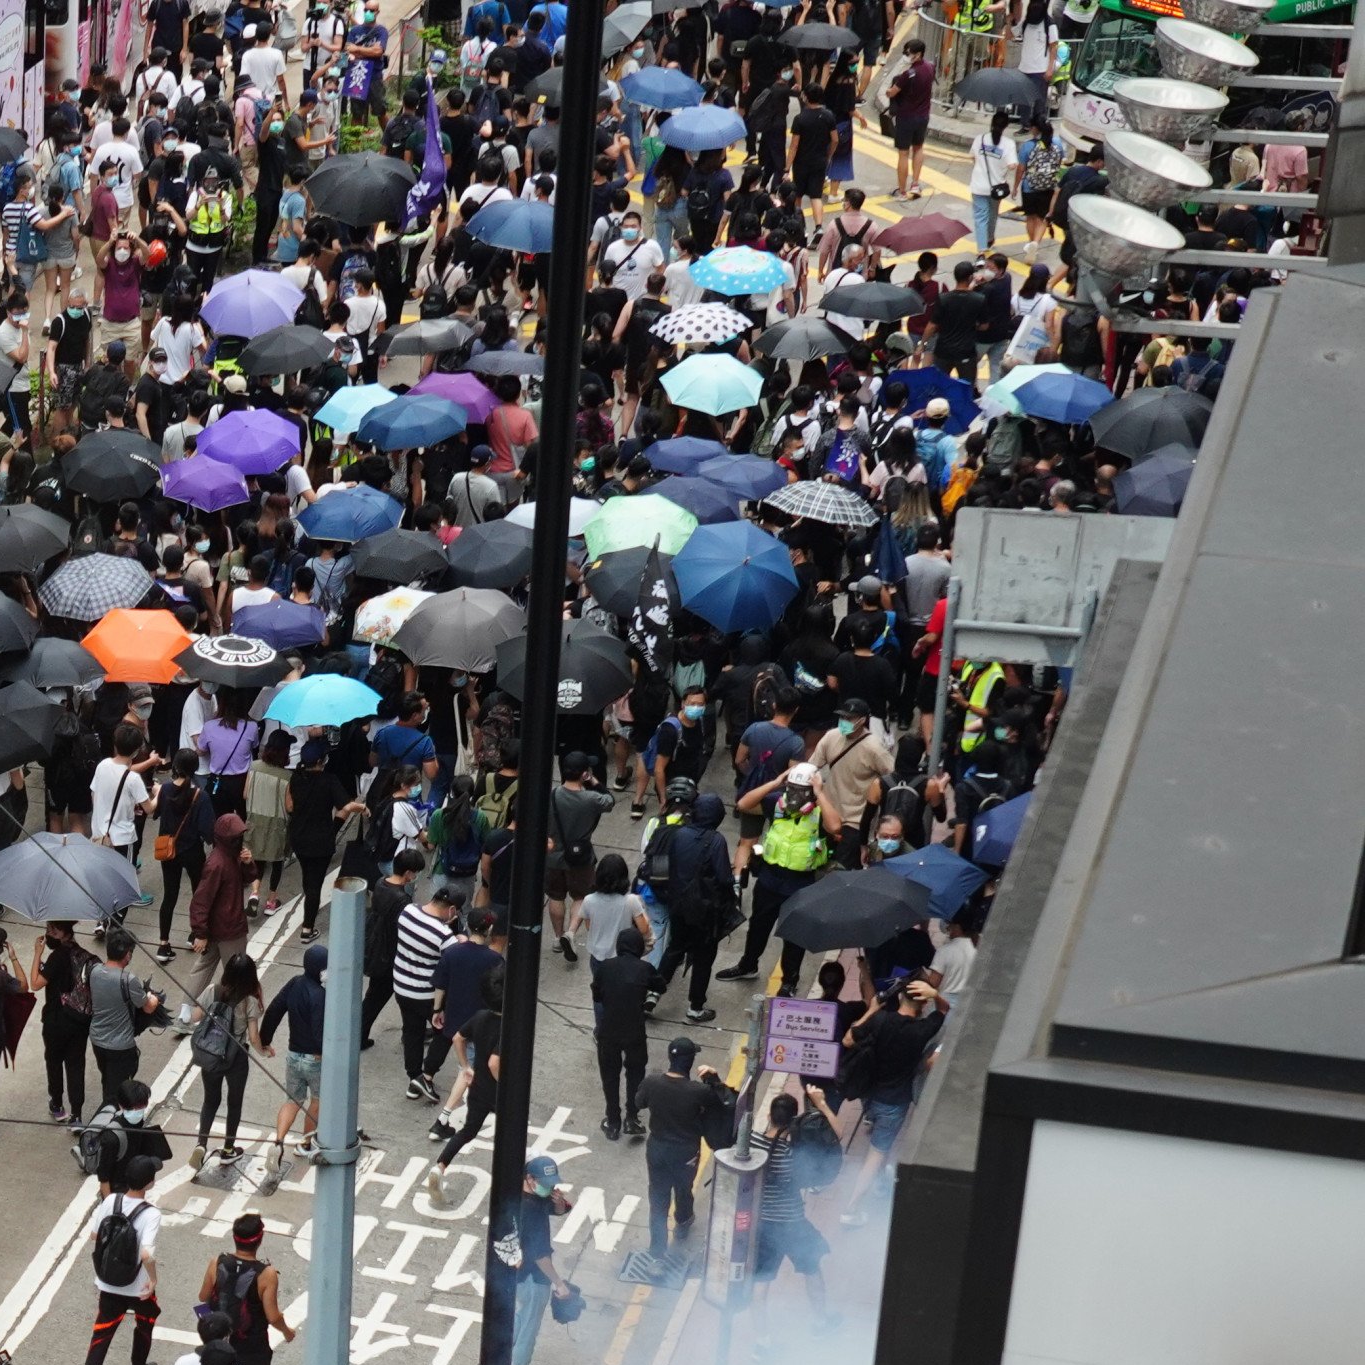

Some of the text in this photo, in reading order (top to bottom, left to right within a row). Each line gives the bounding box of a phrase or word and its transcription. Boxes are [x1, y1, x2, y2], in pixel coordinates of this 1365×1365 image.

[1296, 2, 1325, 14] PUBLIC
[643, 649, 659, 673] TIMES
[786, 1015, 821, 1025] 巴士服務
[786, 1023, 828, 1034] Bus Services
